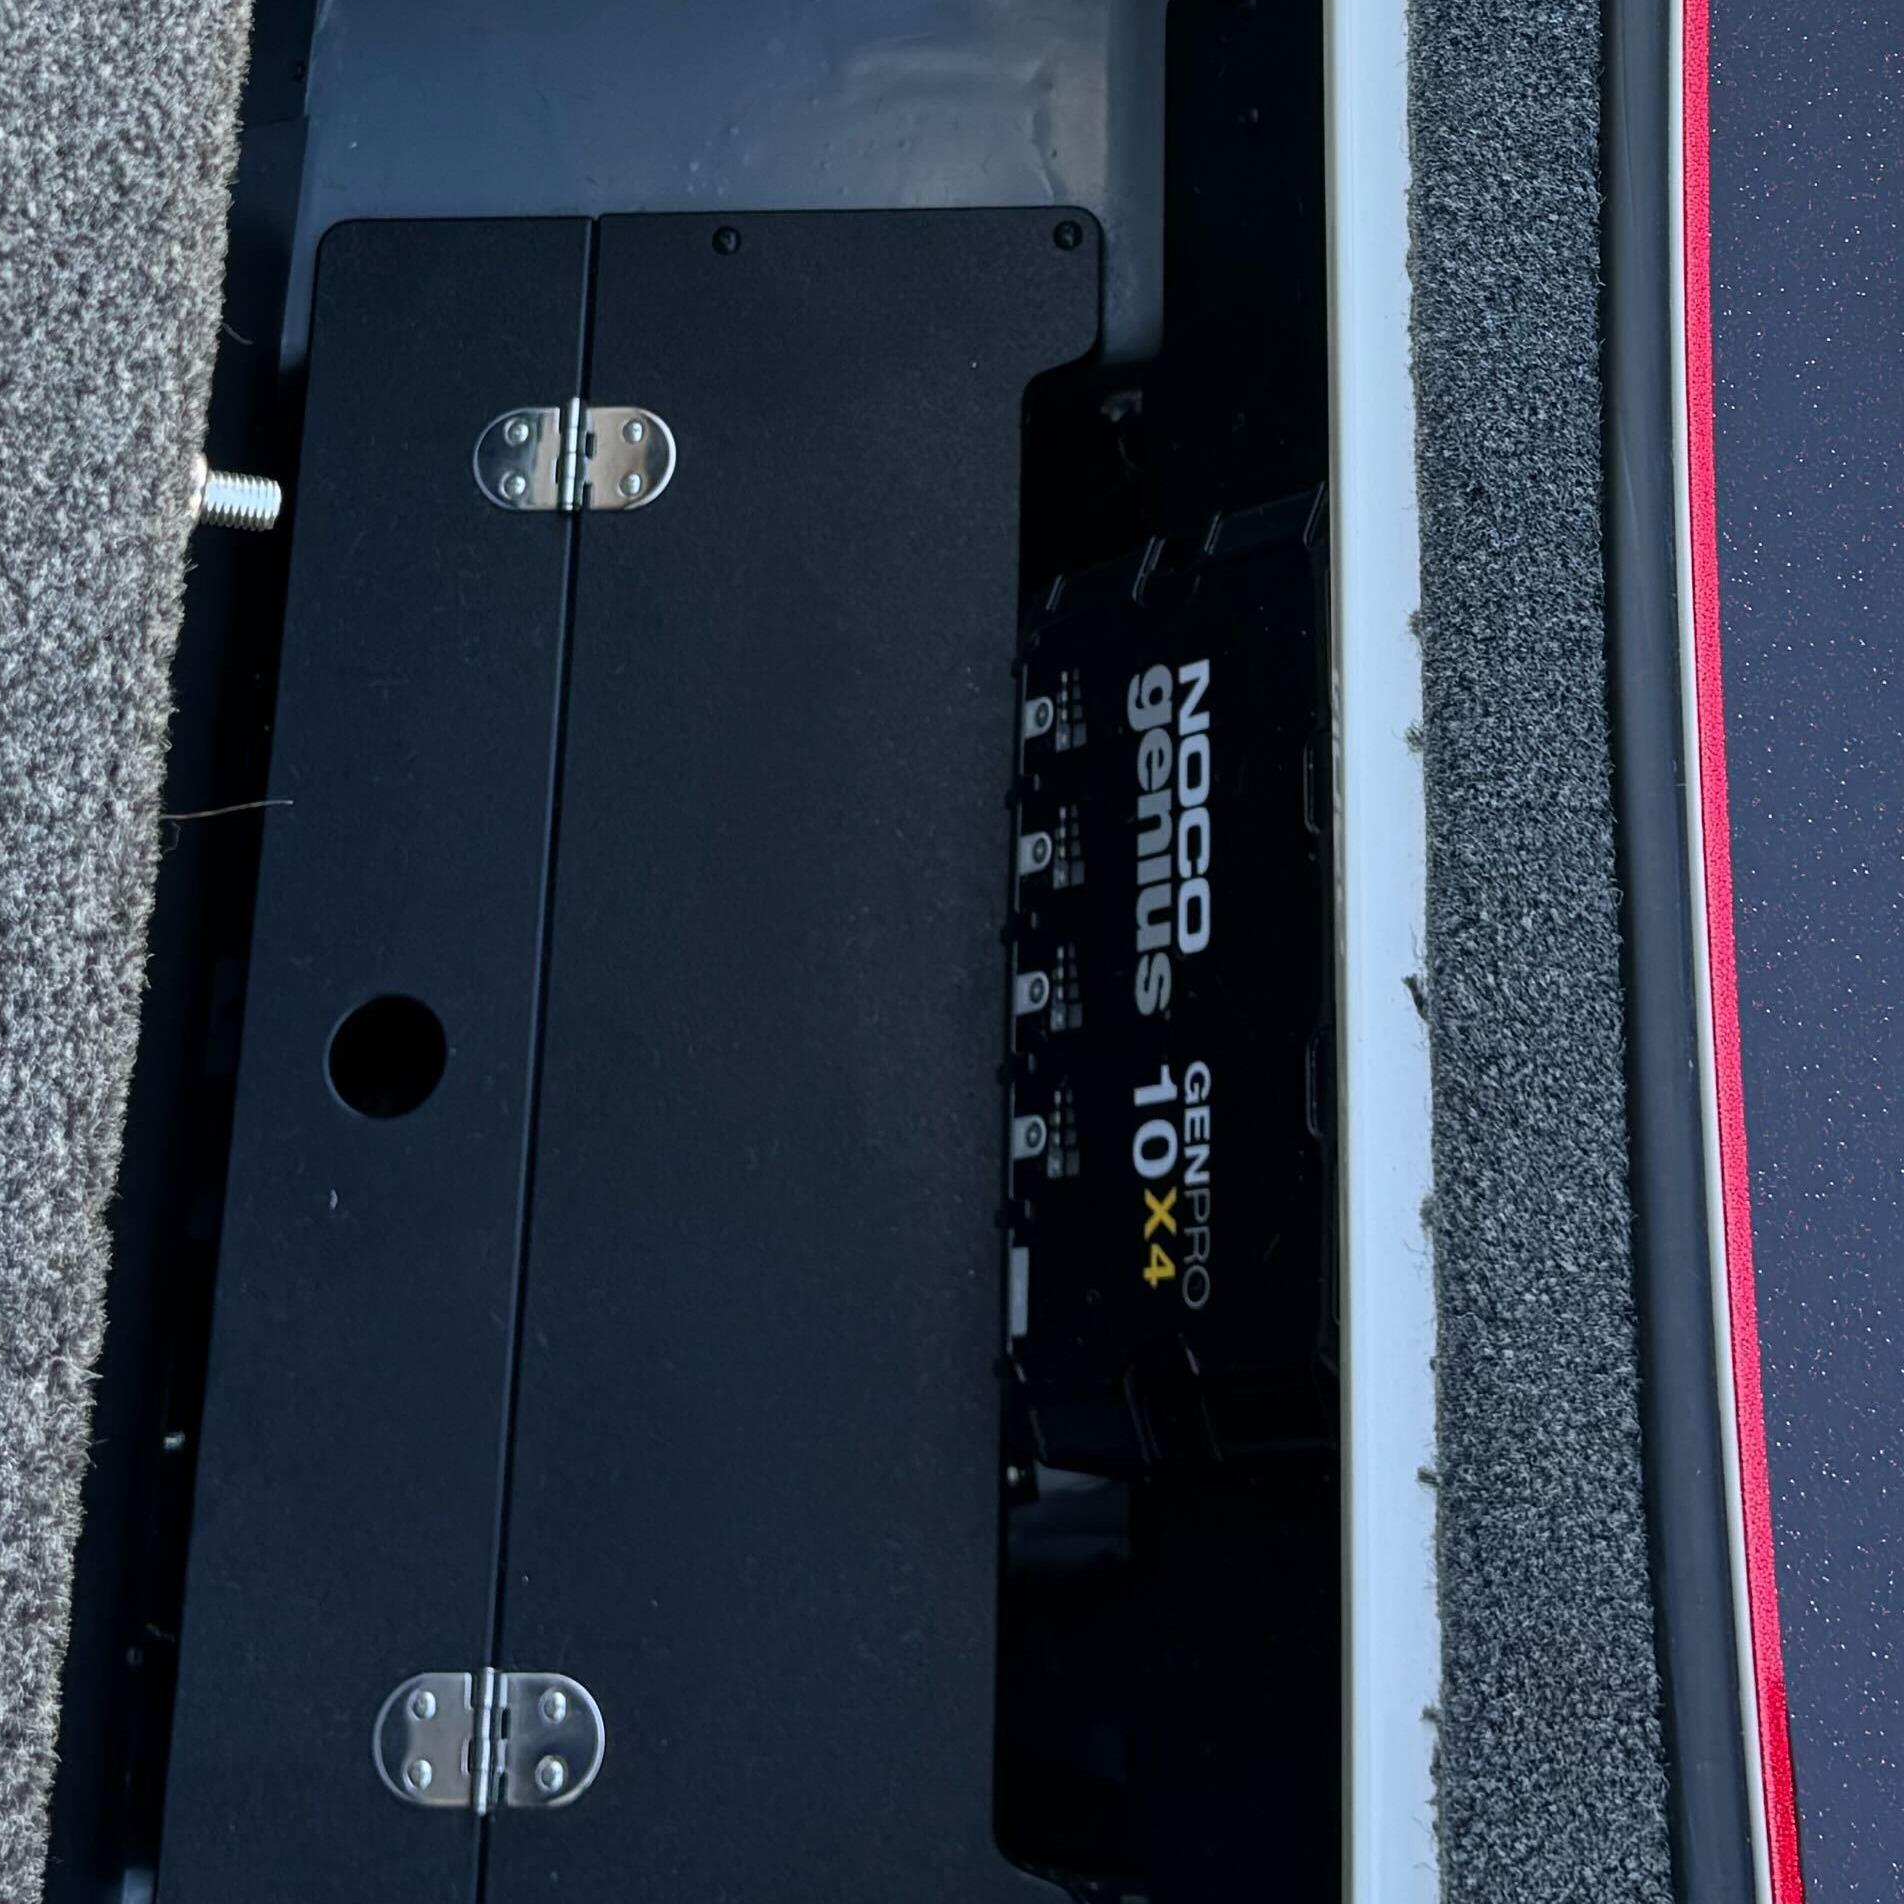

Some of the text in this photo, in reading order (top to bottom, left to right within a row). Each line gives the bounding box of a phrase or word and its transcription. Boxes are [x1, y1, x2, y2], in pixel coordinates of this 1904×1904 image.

[1128, 663, 1177, 1018] genius
[1177, 658, 1212, 955] NOCO
[1181, 1059, 1213, 1310] GENPRO
